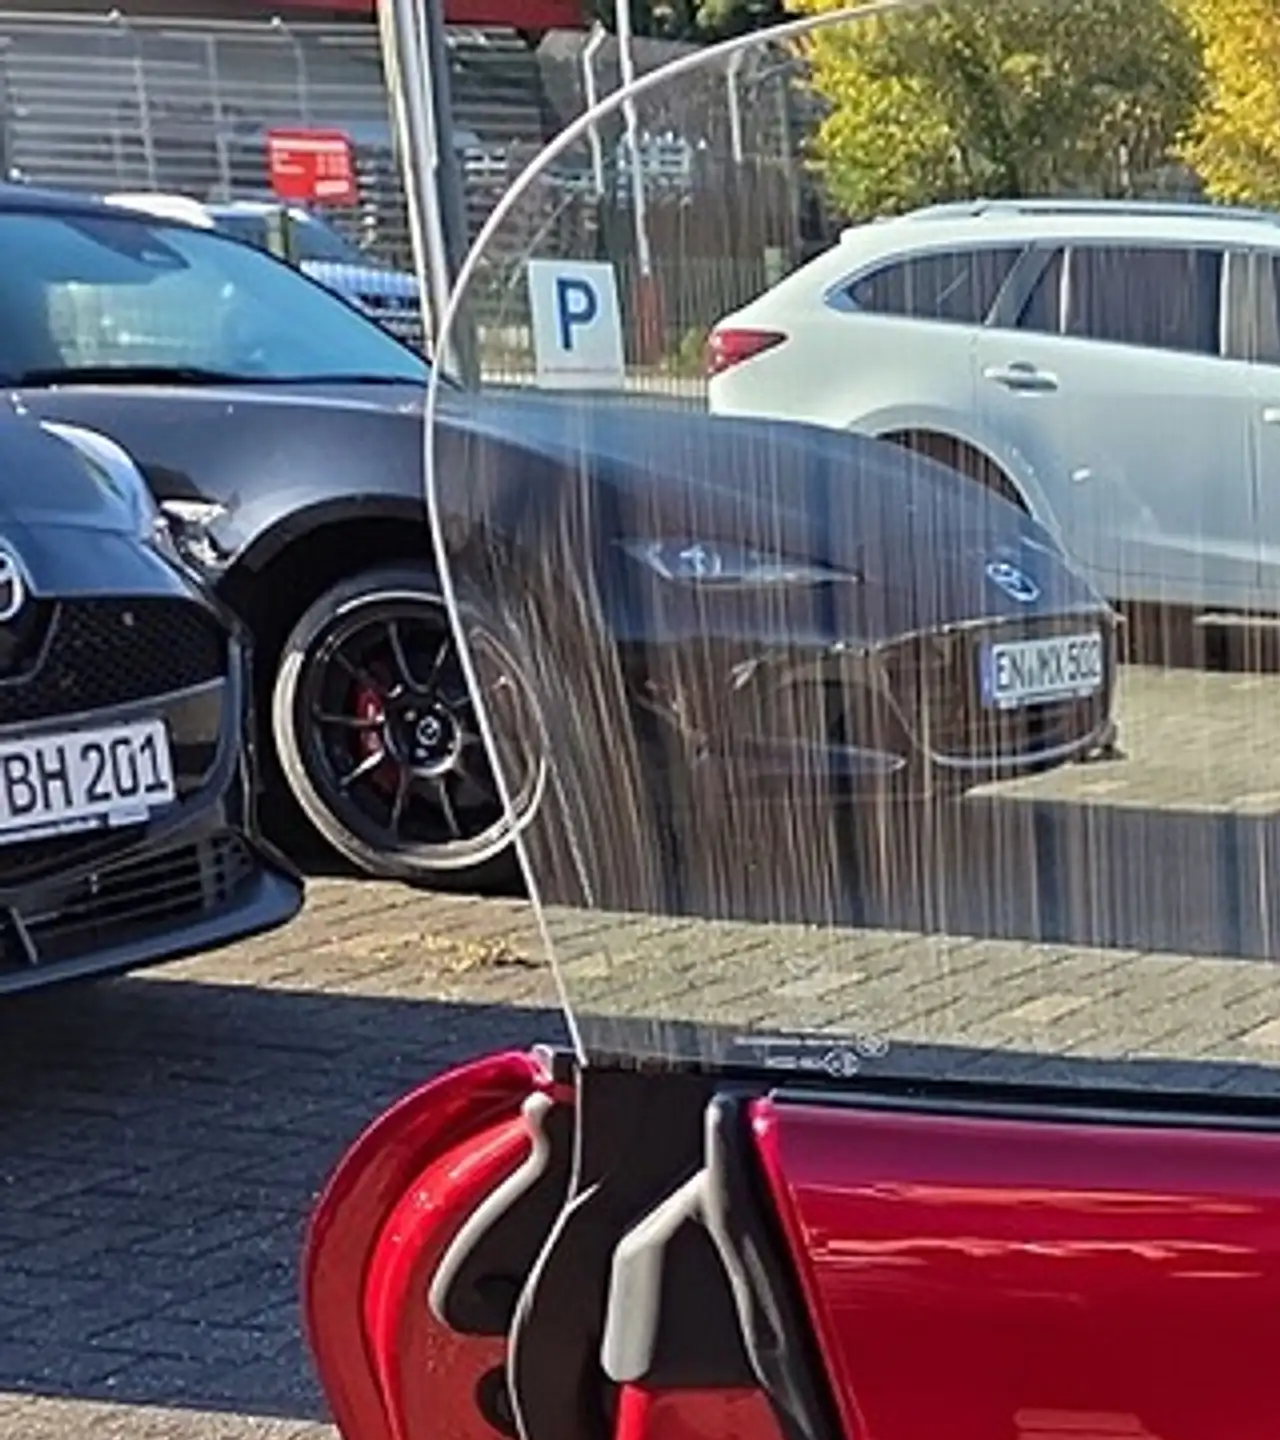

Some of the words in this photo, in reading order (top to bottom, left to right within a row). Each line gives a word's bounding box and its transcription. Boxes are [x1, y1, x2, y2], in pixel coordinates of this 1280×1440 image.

[554, 276, 597, 351] P
[4, 746, 73, 816] BH
[80, 732, 168, 803] 201
